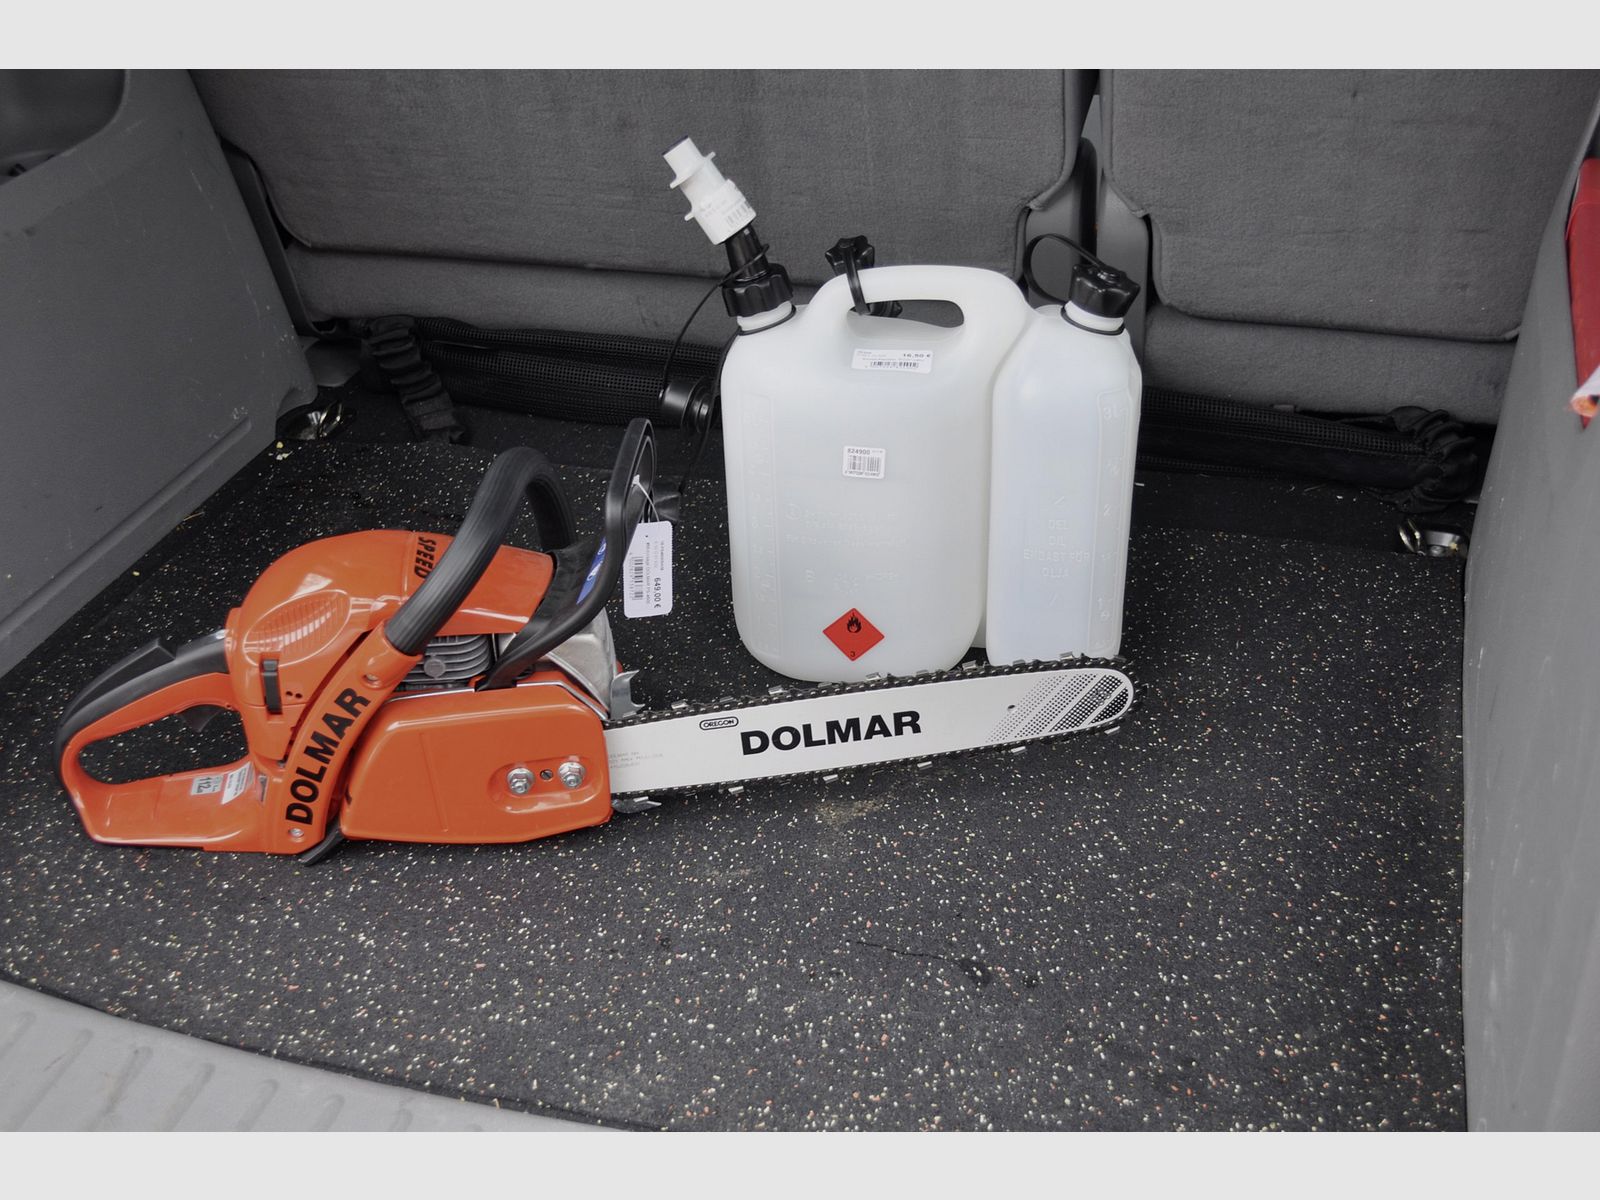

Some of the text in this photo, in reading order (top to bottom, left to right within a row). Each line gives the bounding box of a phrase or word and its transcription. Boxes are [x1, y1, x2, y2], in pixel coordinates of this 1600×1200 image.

[414, 536, 437, 580] SPEED
[654, 577, 662, 602] 649,00
[703, 718, 735, 728] OREGON
[740, 710, 922, 756] DOLMAR
[285, 687, 372, 825] DOLMAR
